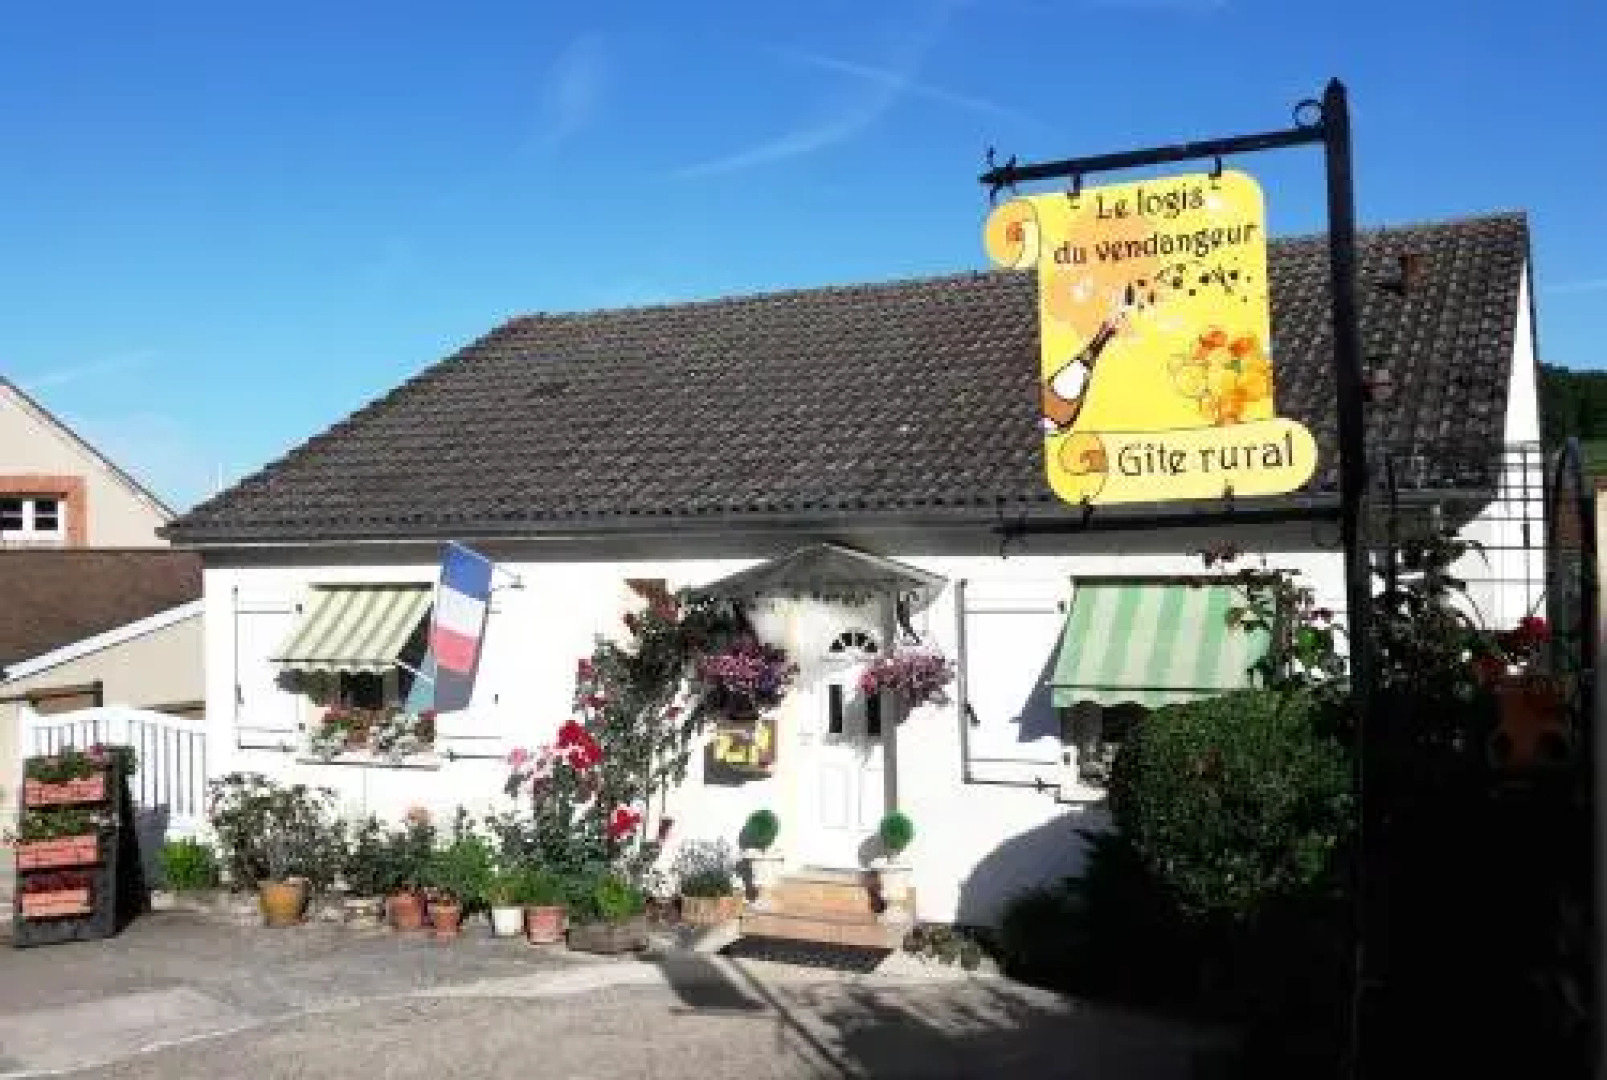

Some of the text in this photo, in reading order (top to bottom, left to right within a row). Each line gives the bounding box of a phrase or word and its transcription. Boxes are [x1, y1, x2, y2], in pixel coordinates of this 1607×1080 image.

[1096, 183, 1205, 219] Le logis
[1054, 222, 1258, 264] du vendangeur
[1199, 429, 1294, 473] rural
